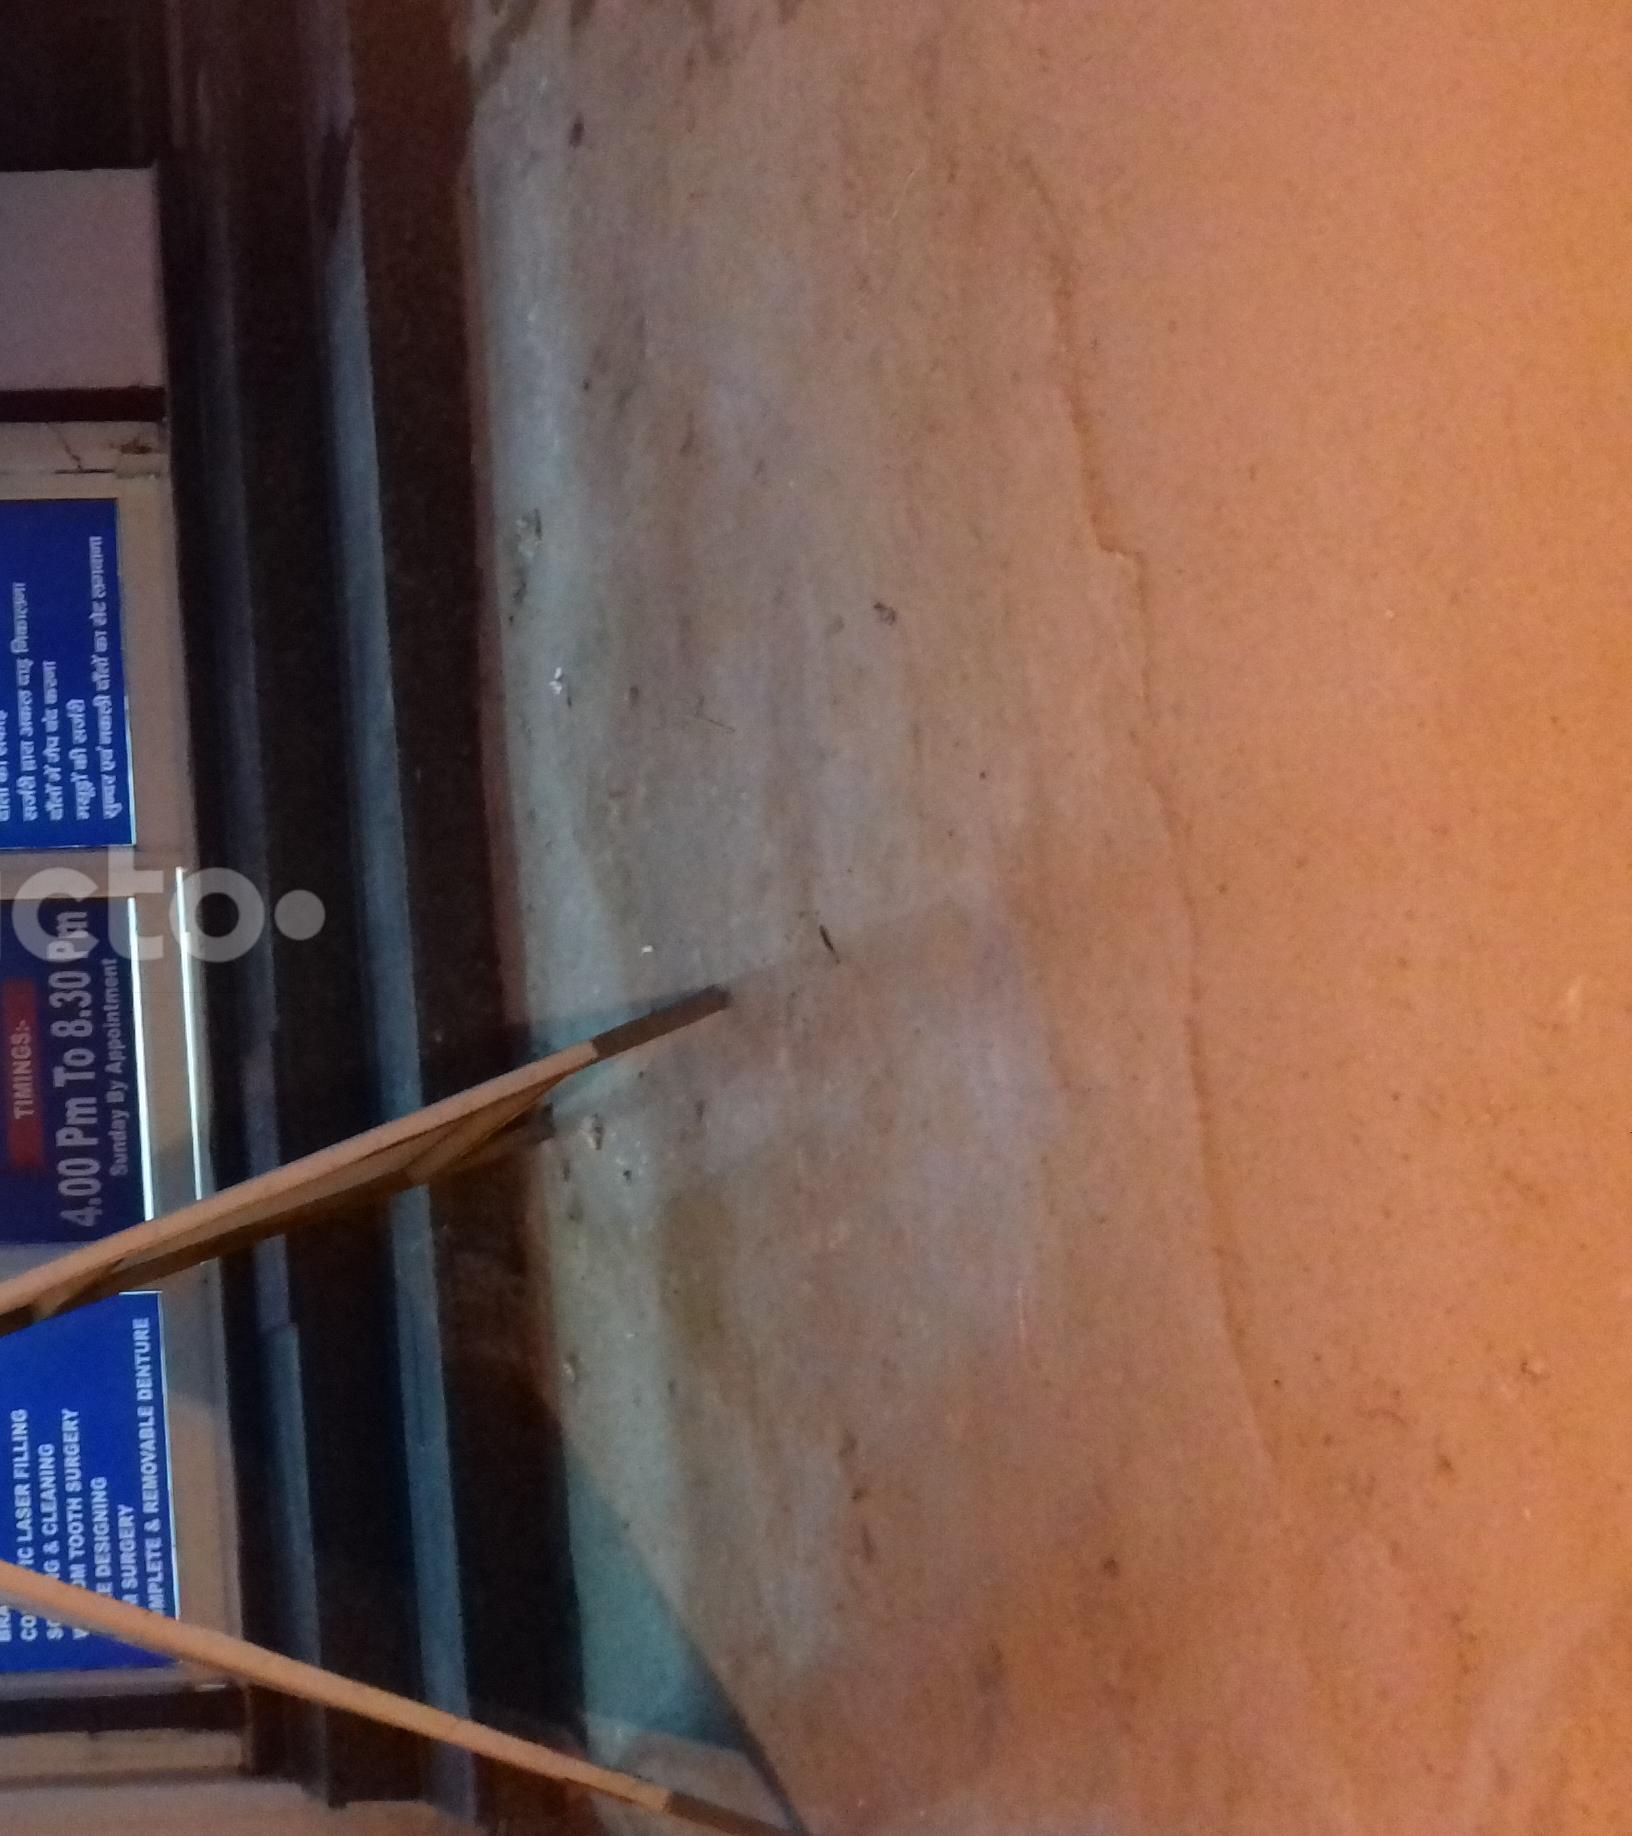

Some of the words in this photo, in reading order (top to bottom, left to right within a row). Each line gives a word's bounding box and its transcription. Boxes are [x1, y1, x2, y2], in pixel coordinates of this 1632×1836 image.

[47, 911, 89, 959] Pm
[49, 971, 93, 1037] 8.30
[101, 958, 126, 1074] Appointment
[52, 1048, 94, 1087] To
[104, 1080, 129, 1103] By
[55, 1097, 99, 1146] Pm
[104, 1110, 130, 1176] Sunday
[57, 1158, 103, 1227] 4.00
[132, 1318, 153, 1400] DENTURE
[10, 1409, 30, 1479] FILLING
[62, 1408, 82, 1492] SURGERY
[137, 1406, 159, 1513] REMOVABLE
[14, 1484, 33, 1541] LASER
[38, 1443, 58, 1535] CLEANING
[42, 1540, 60, 1554] &
[66, 1497, 85, 1560] TOOTH
[90, 1477, 112, 1577] DESIGNING
[117, 1504, 138, 1589] SURGERY
[144, 1518, 161, 1532] &
